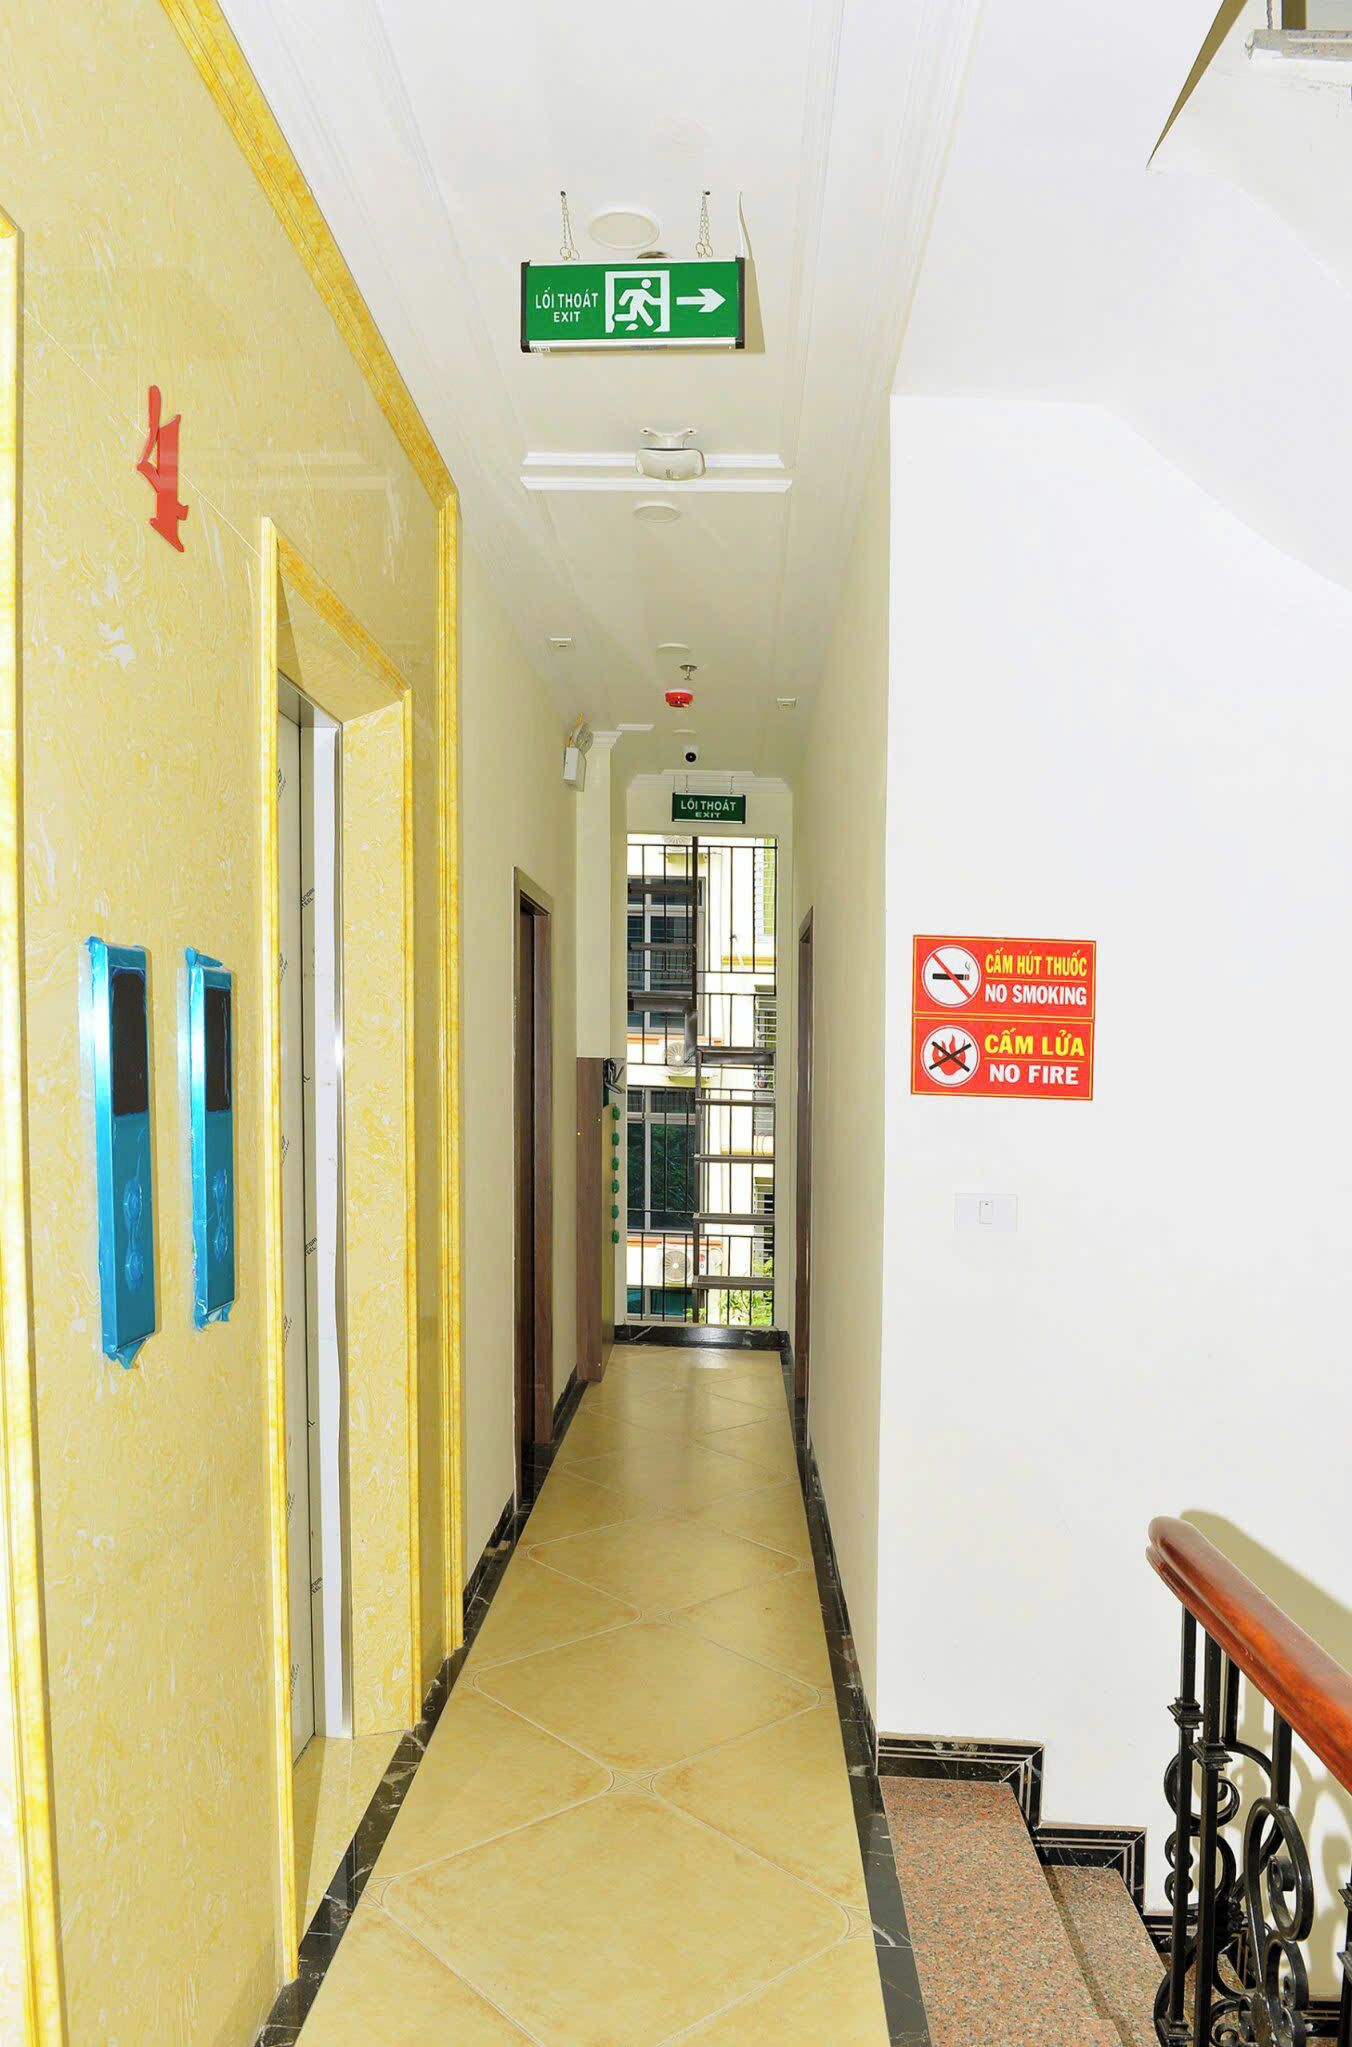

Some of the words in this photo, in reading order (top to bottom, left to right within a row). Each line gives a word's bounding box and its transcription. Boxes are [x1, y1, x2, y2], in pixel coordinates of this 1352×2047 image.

[535, 286, 555, 310] LỐI
[558, 289, 599, 309] THOÁT
[553, 311, 581, 323] EXIT
[700, 799, 737, 811] THOÁT
[985, 946, 1013, 975] CẤM
[1016, 950, 1042, 976] HÚT
[1046, 949, 1088, 977] THUỐC
[985, 983, 1008, 1003] NO
[1012, 984, 1087, 1006] SMOKING
[984, 1027, 1034, 1055] CẤM
[1041, 1029, 1085, 1057] LỬA
[989, 1063, 1020, 1084] NO
[1028, 1064, 1079, 1085] FIRE
